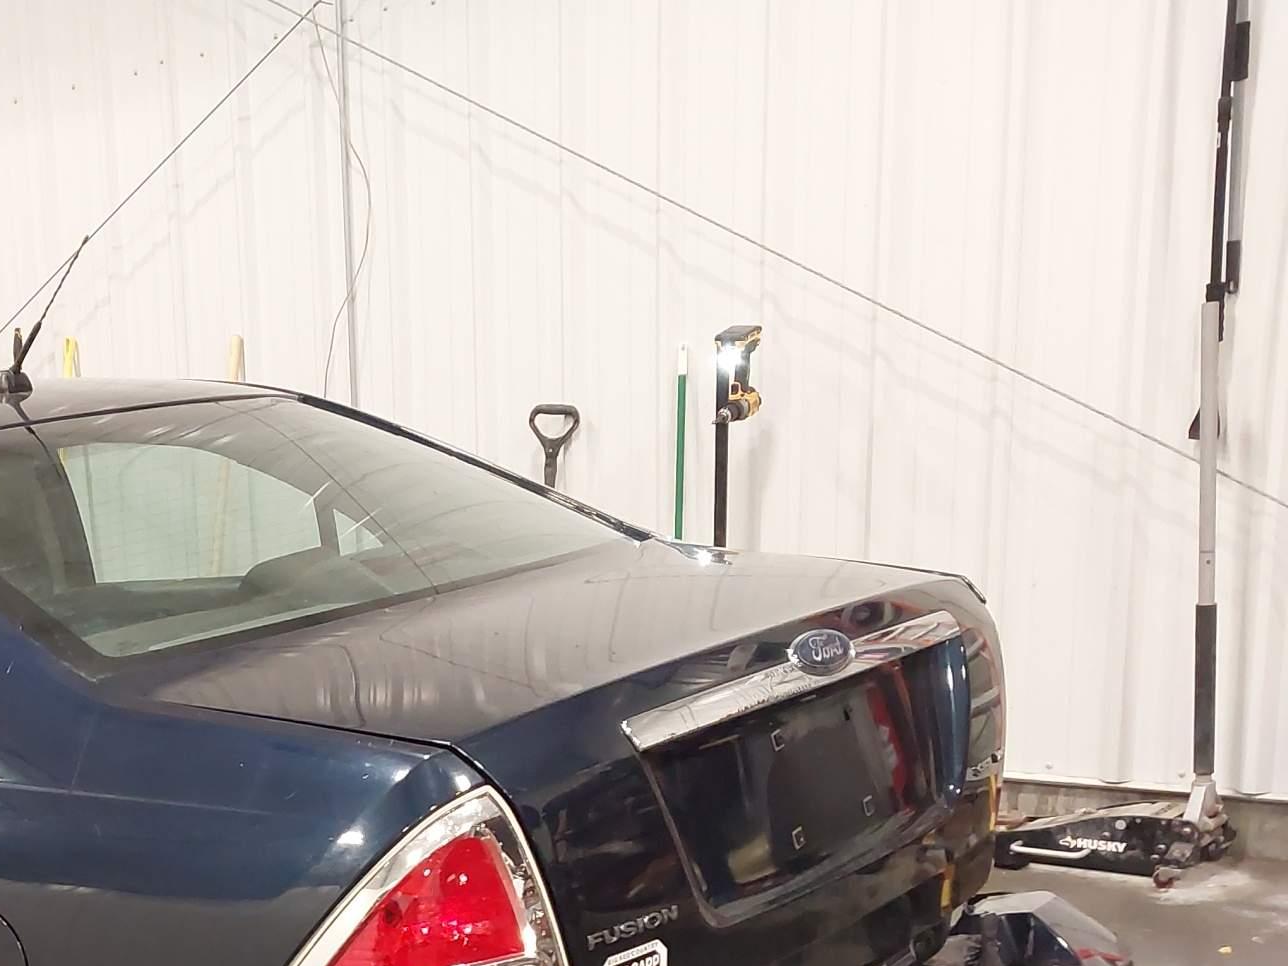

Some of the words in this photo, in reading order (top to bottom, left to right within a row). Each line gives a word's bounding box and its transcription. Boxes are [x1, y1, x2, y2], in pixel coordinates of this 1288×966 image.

[809, 634, 844, 661] Ford
[1080, 838, 1128, 853] HUSKY
[587, 905, 678, 951] FUSION
